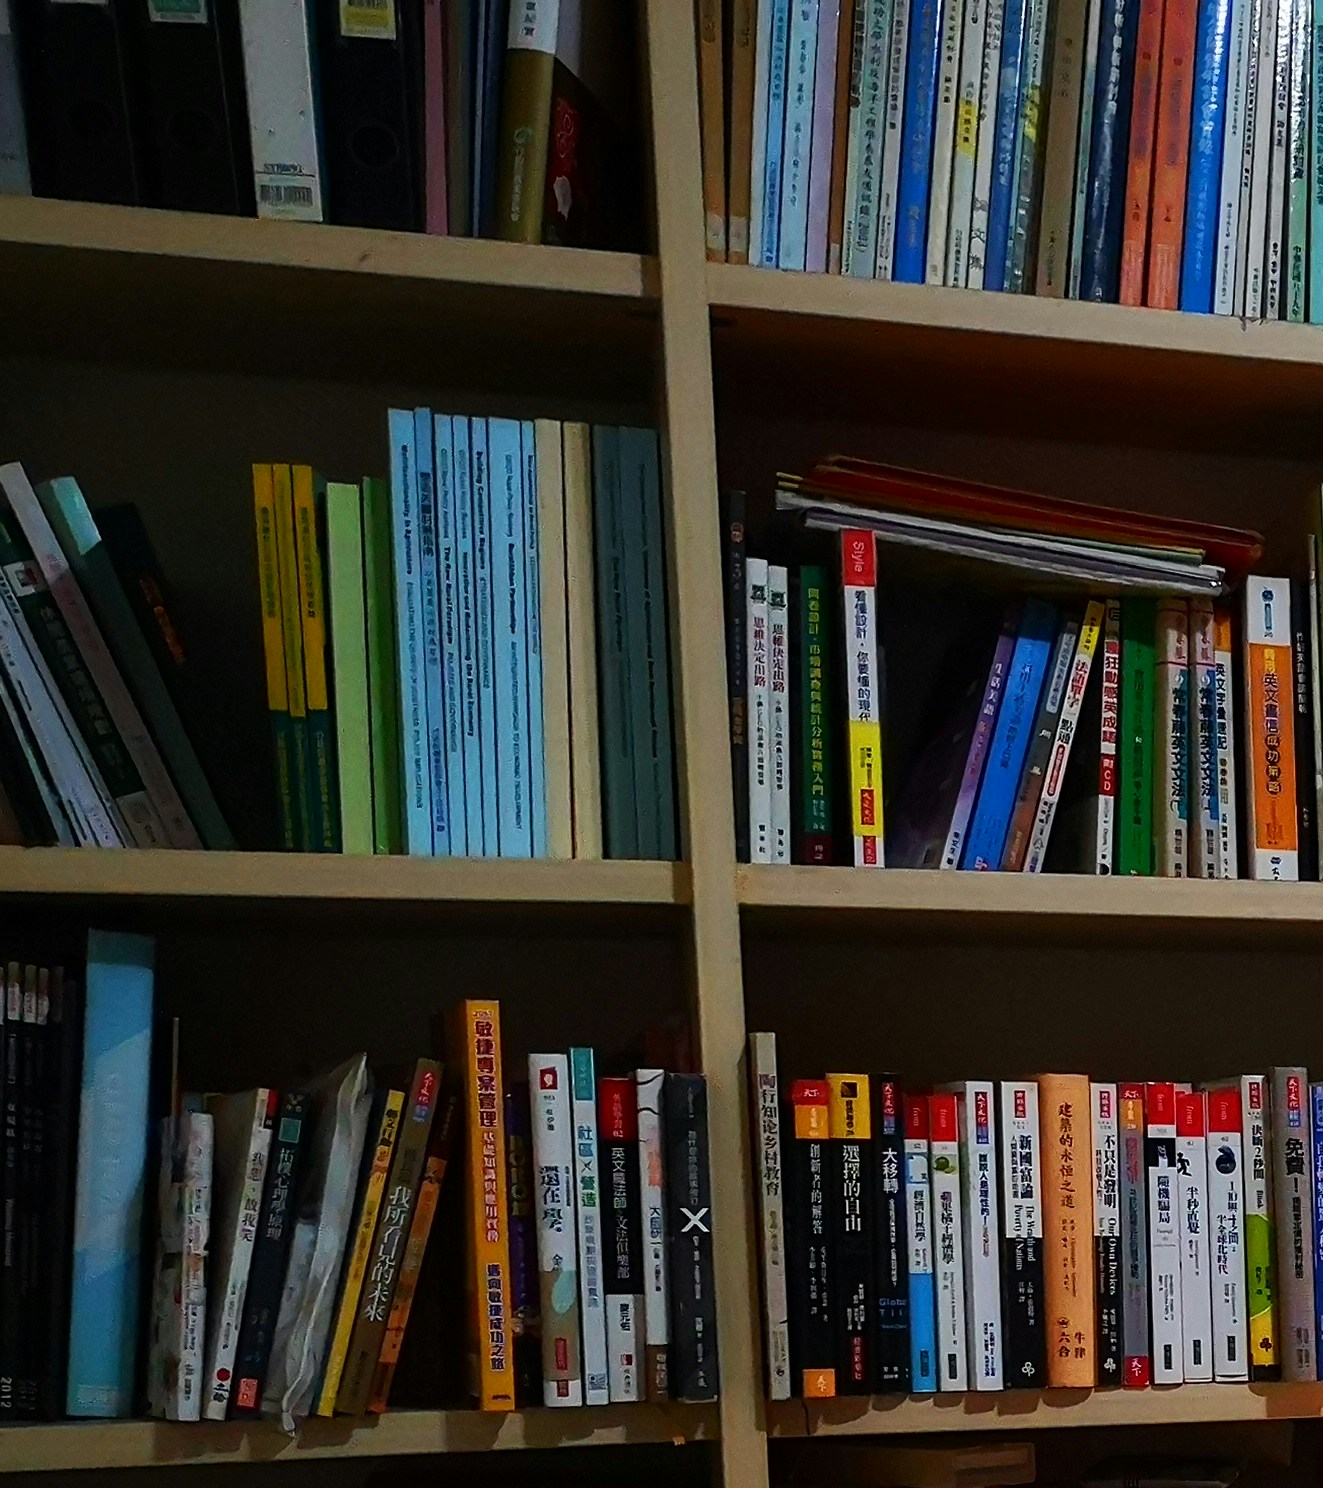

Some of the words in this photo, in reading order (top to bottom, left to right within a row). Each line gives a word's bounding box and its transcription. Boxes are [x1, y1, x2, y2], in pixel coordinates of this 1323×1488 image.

[842, 1145, 861, 1232] 選擇的自由
[882, 1148, 899, 1193] 大移轉
[1103, 1134, 1117, 1209] 不只是發明
